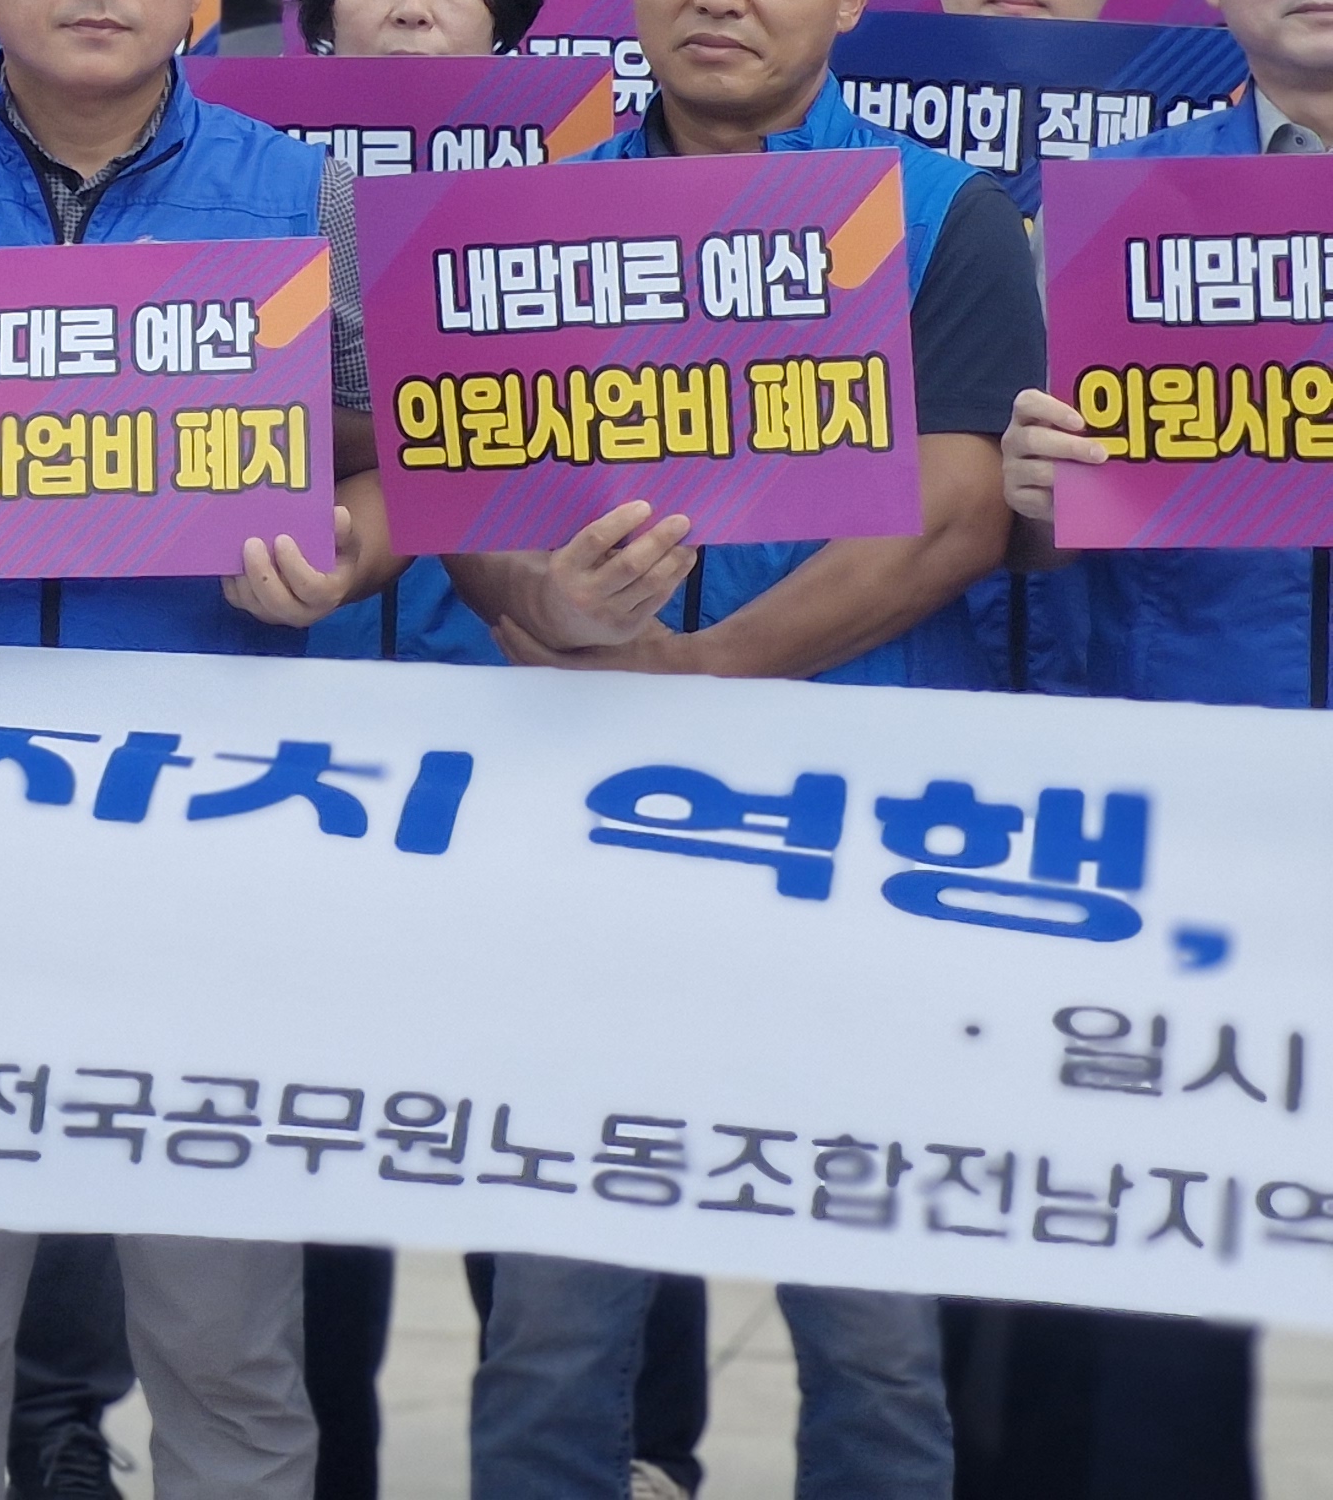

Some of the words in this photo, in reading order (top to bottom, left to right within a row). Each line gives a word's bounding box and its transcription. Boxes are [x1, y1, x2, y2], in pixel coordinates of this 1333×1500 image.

[437, 237, 685, 331] 내맘대로
[700, 231, 829, 318] 예산
[1130, 236, 1333, 322] 내맘대
[134, 301, 255, 373] 예산
[175, 405, 308, 491] 폐지
[397, 363, 730, 468] 의원사업비
[749, 357, 889, 451] 폐지
[585, 764, 1231, 973] 역행,
[1052, 1005, 1304, 1112] 일시
